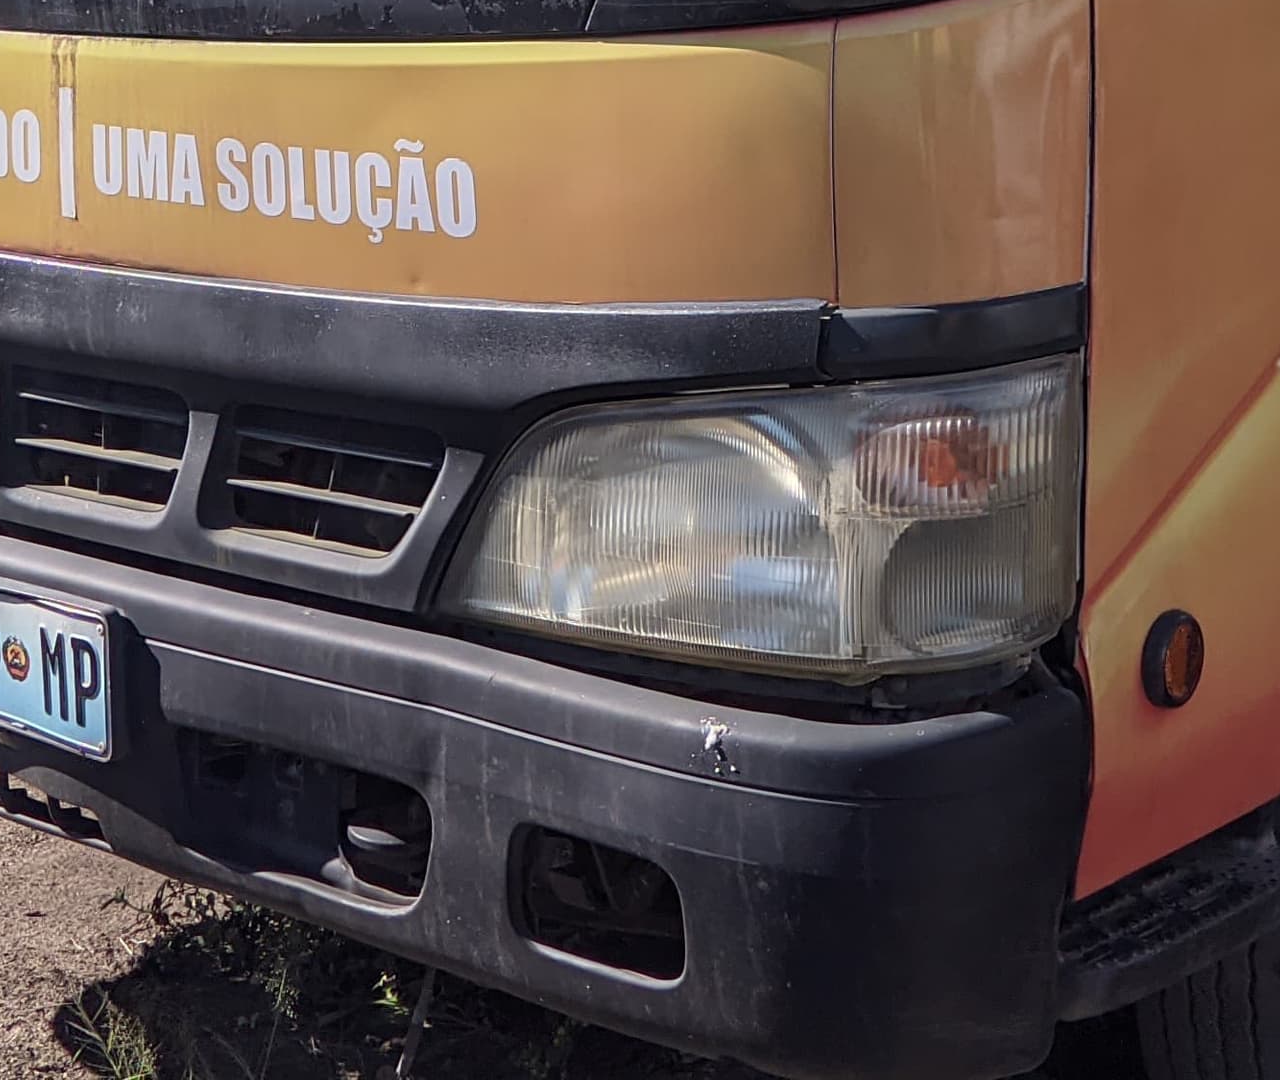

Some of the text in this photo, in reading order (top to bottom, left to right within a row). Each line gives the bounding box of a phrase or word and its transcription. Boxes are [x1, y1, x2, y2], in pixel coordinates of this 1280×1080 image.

[92, 123, 206, 207] UMA
[215, 137, 478, 244] SOLUÇÃO
[39, 623, 101, 728] MP
